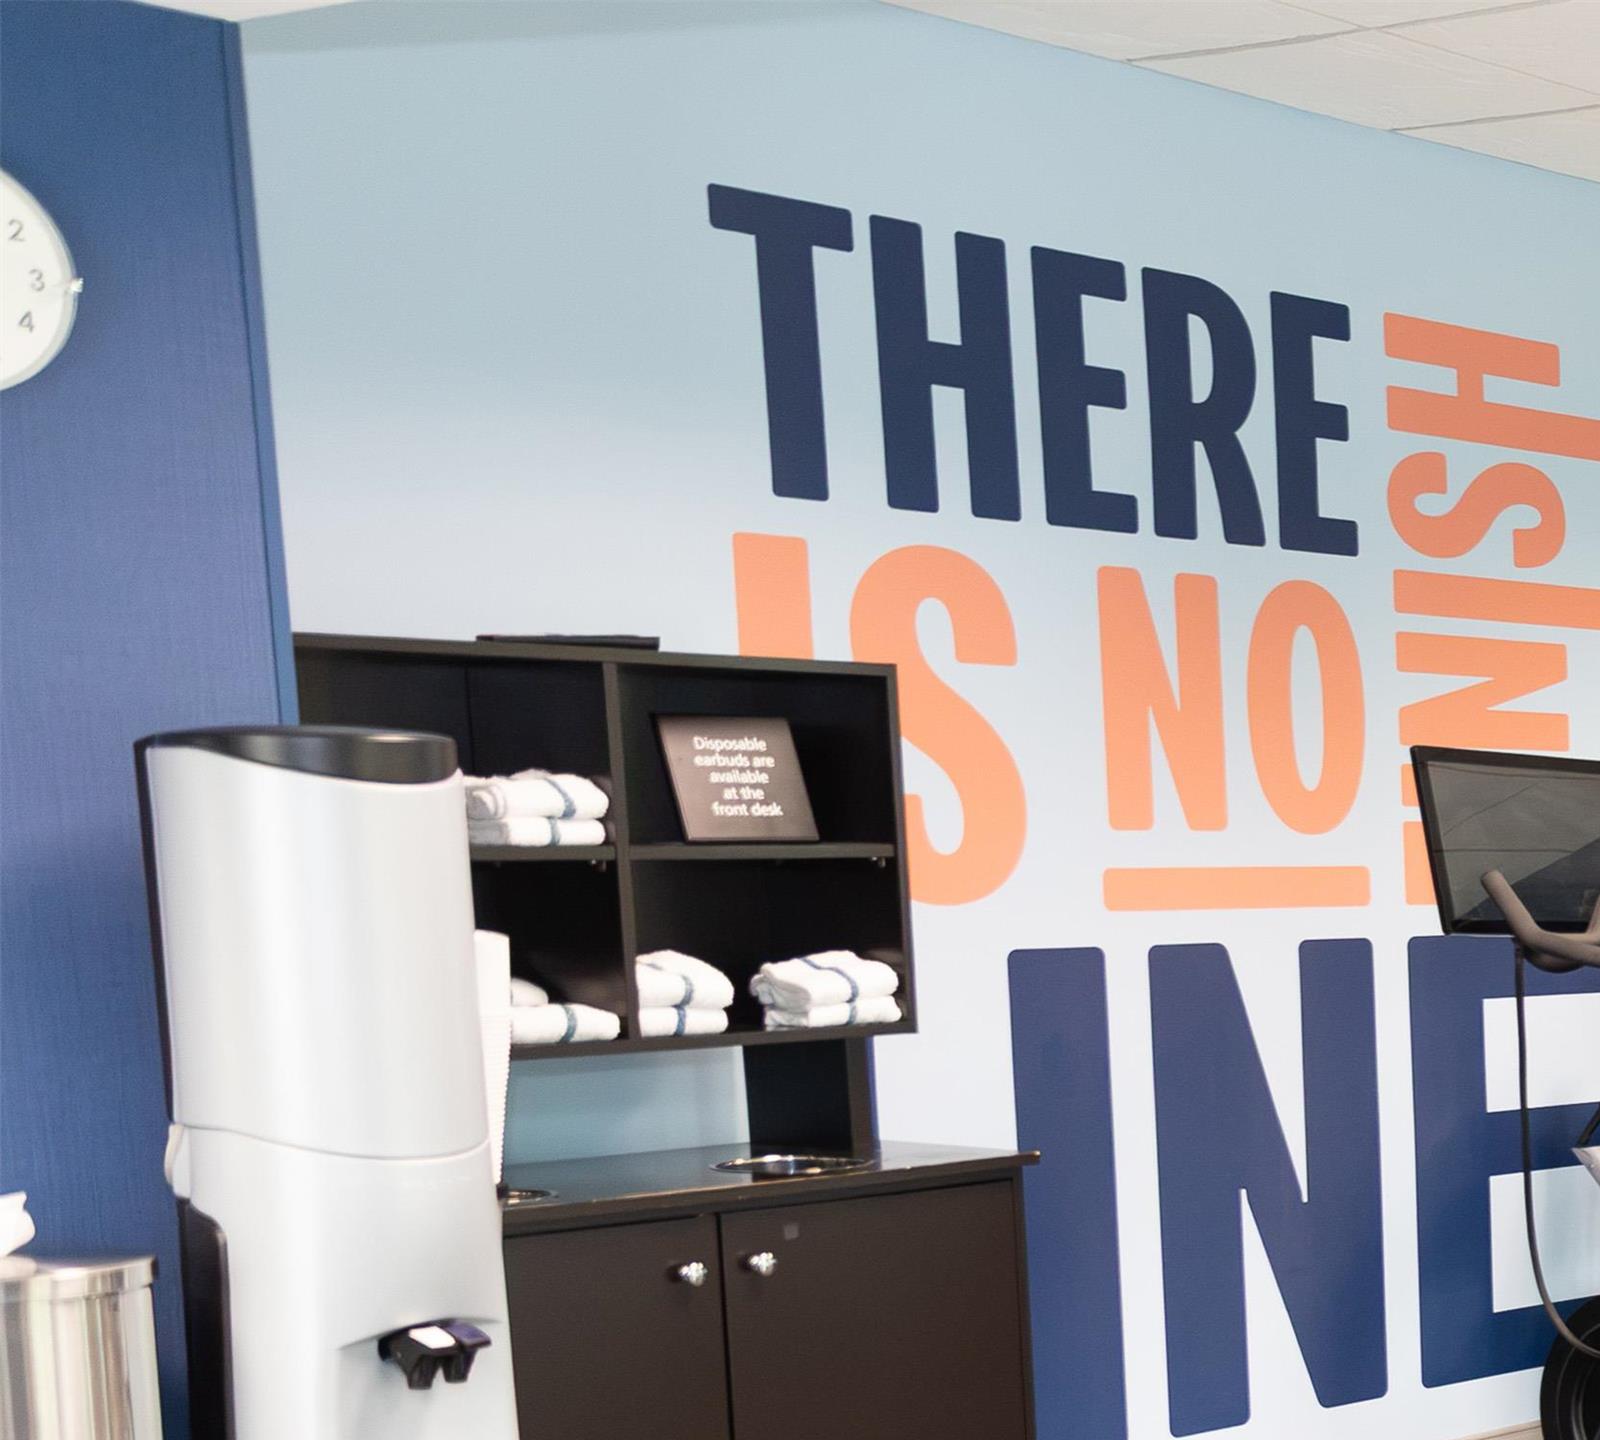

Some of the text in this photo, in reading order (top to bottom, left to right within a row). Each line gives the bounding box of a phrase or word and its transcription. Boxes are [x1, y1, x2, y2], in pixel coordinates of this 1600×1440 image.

[9, 218, 25, 241] 2
[29, 269, 45, 292] 3
[19, 311, 34, 332] 4
[707, 183, 1358, 557] THERE
[1096, 566, 1365, 834] NO
[693, 736, 767, 752] Disposable
[693, 753, 775, 768] earbuds are
[709, 769, 769, 784] available
[723, 786, 765, 800] at the
[711, 801, 783, 816] front desk
